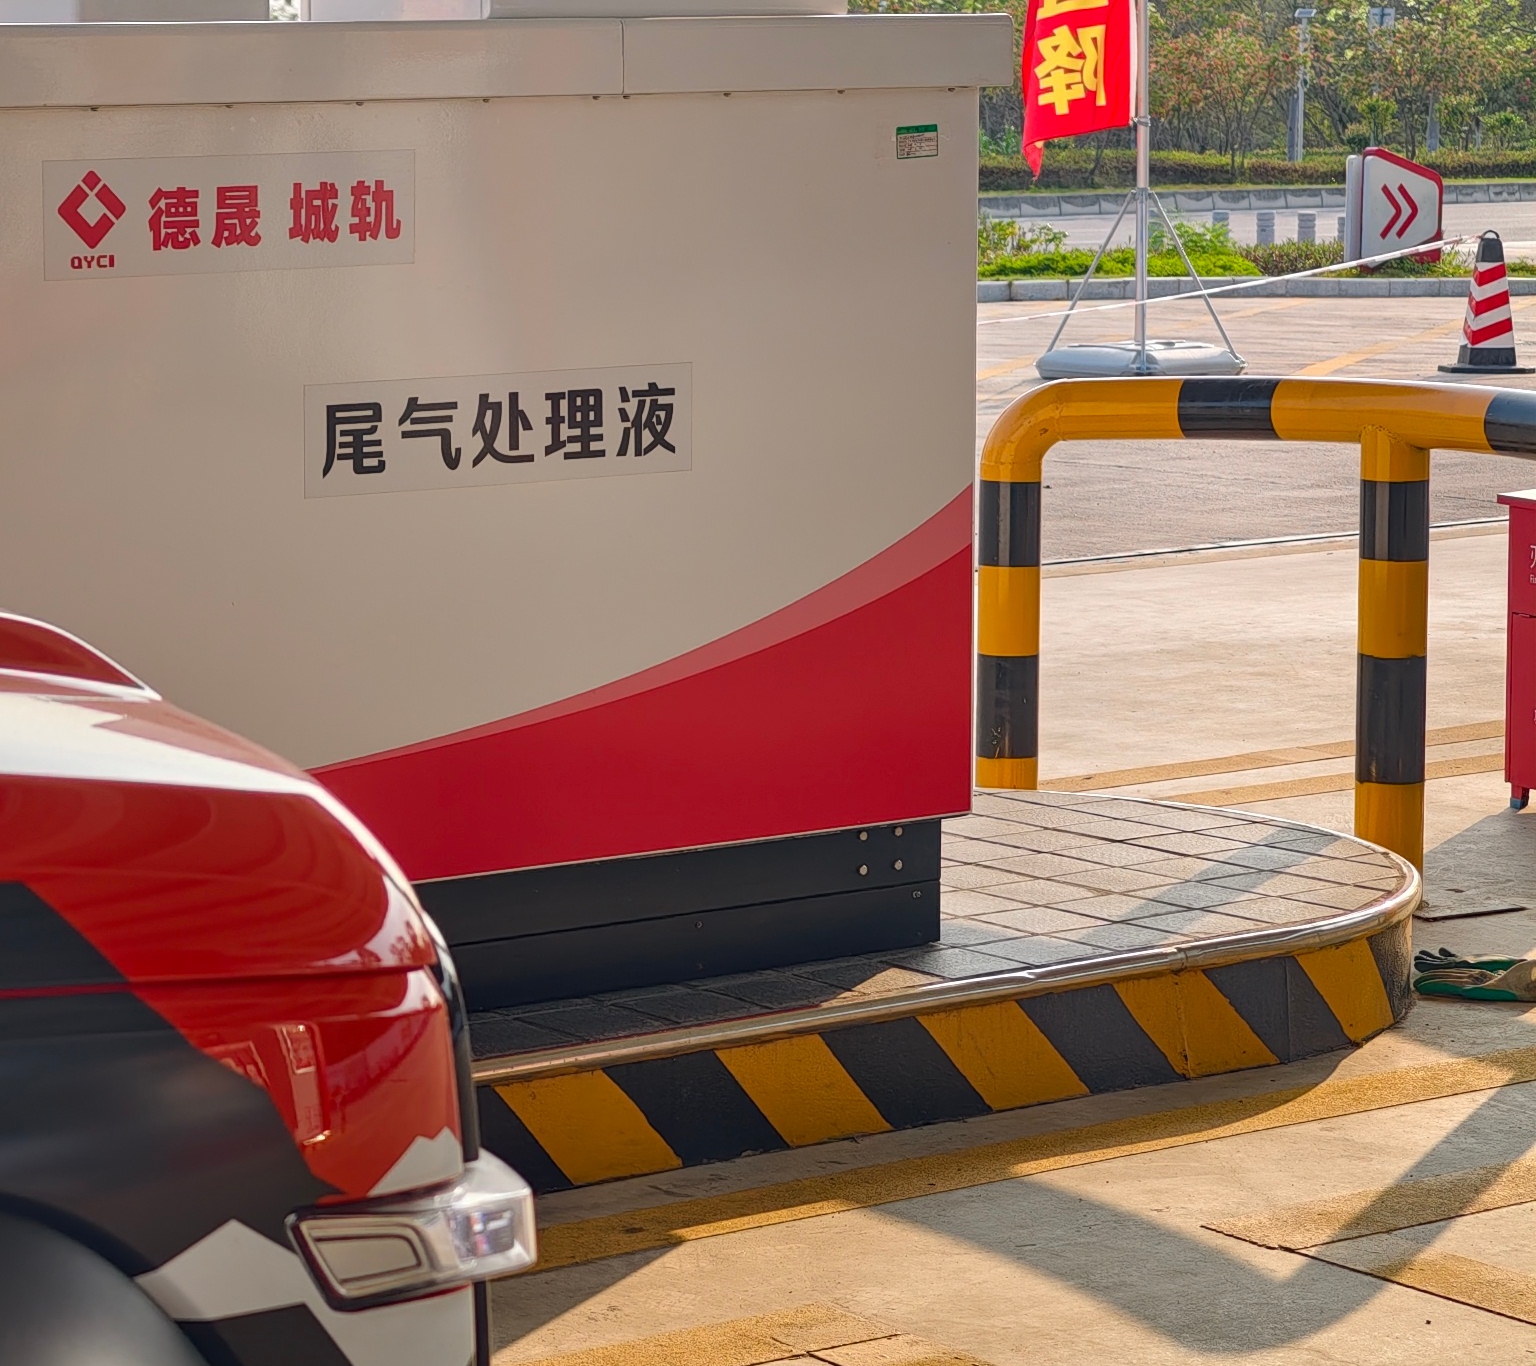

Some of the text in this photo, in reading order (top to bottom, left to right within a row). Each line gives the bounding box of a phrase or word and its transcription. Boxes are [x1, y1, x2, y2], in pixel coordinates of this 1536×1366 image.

[148, 179, 402, 252] 德晟 城轨
[70, 254, 115, 270] QYCI
[322, 381, 676, 479] 尾气处理液
